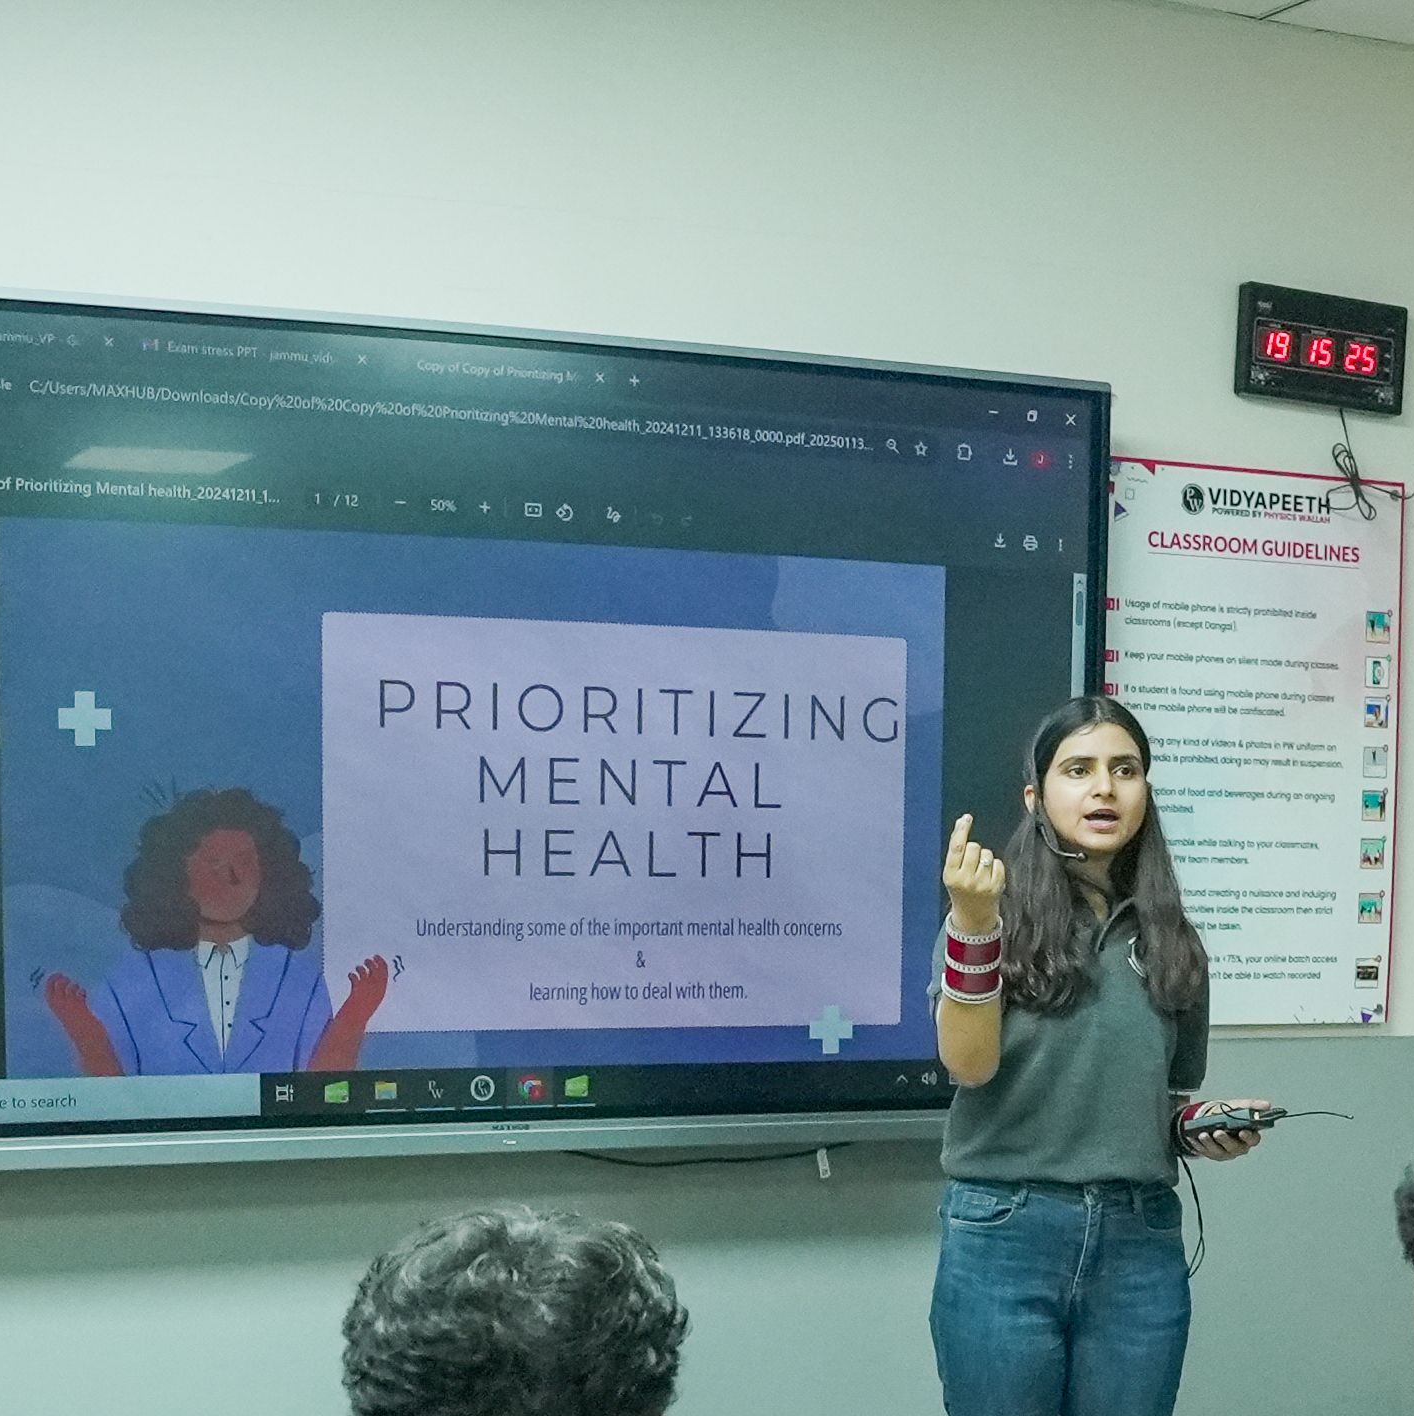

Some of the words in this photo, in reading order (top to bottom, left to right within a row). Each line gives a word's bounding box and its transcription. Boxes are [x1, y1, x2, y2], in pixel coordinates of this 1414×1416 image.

[1267, 331, 1291, 362] 19
[1309, 338, 1333, 366] 15
[1344, 343, 1376, 374] 25
[14, 477, 92, 498] Prioritizing
[95, 481, 144, 496] Mental
[344, 494, 359, 508] 12
[430, 498, 457, 513] 50%
[1208, 487, 1330, 515] VIDYAPEETH
[1212, 507, 1250, 518] POWERED
[1252, 509, 1262, 518] BY
[1264, 511, 1297, 521] PHYSICS
[1298, 514, 1331, 524] WALLAH
[1147, 530, 1258, 554] CLASSROOM
[1261, 539, 1360, 563] GUIDELINES
[378, 679, 900, 743] PRIORITIZING
[478, 756, 782, 810] MENTAL
[482, 828, 773, 879] HEALTH
[416, 917, 525, 942] Understanding
[526, 921, 566, 937] some
[569, 916, 585, 937] of
[587, 917, 611, 936] the
[613, 918, 684, 941] important
[686, 917, 734, 936] mental
[737, 917, 780, 937] health
[782, 922, 843, 937] concerns
[634, 949, 647, 970] &
[529, 982, 588, 1006] learning
[590, 982, 622, 1001] how
[624, 984, 639, 1000] to
[641, 981, 672, 1000] deal
[674, 981, 705, 1000] with
[708, 981, 748, 1000] them.
[11, 1096, 27, 1109] to
[30, 1093, 77, 1108] search
